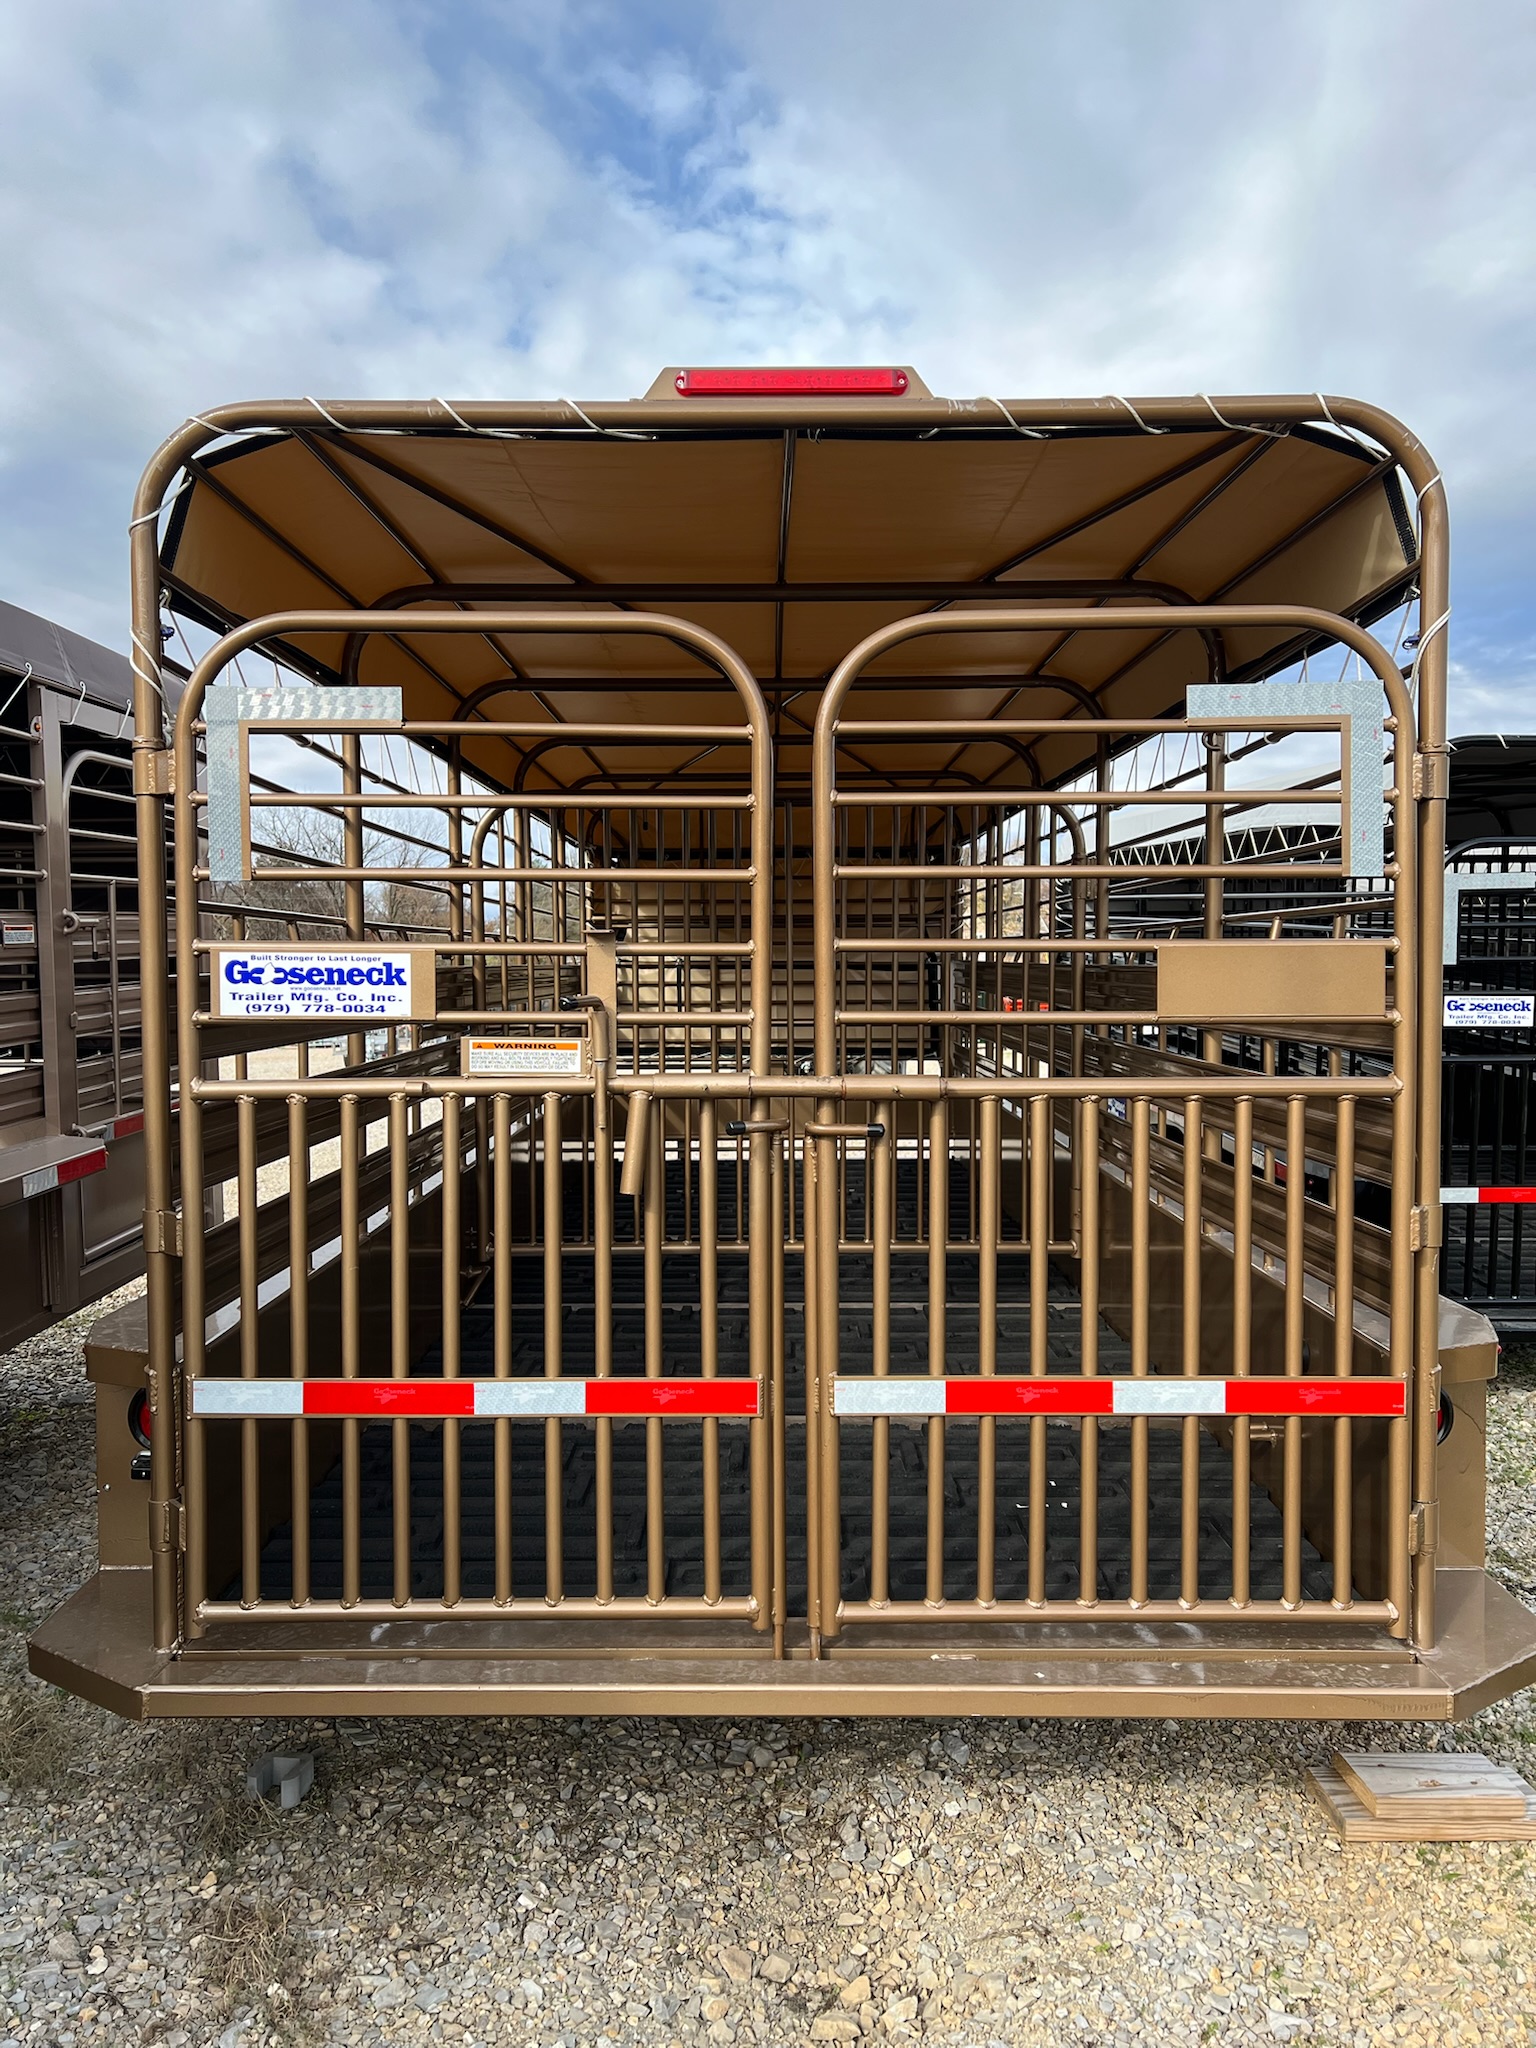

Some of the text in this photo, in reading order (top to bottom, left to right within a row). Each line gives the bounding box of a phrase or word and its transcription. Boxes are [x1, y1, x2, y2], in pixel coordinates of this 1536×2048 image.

[225, 960, 406, 986] Gooseneck
[229, 992, 403, 1002] Trailer Mfg. Co. Inc.
[245, 1004, 386, 1014] (979) 778-0034
[1447, 1000, 1531, 1011] Gooseneck
